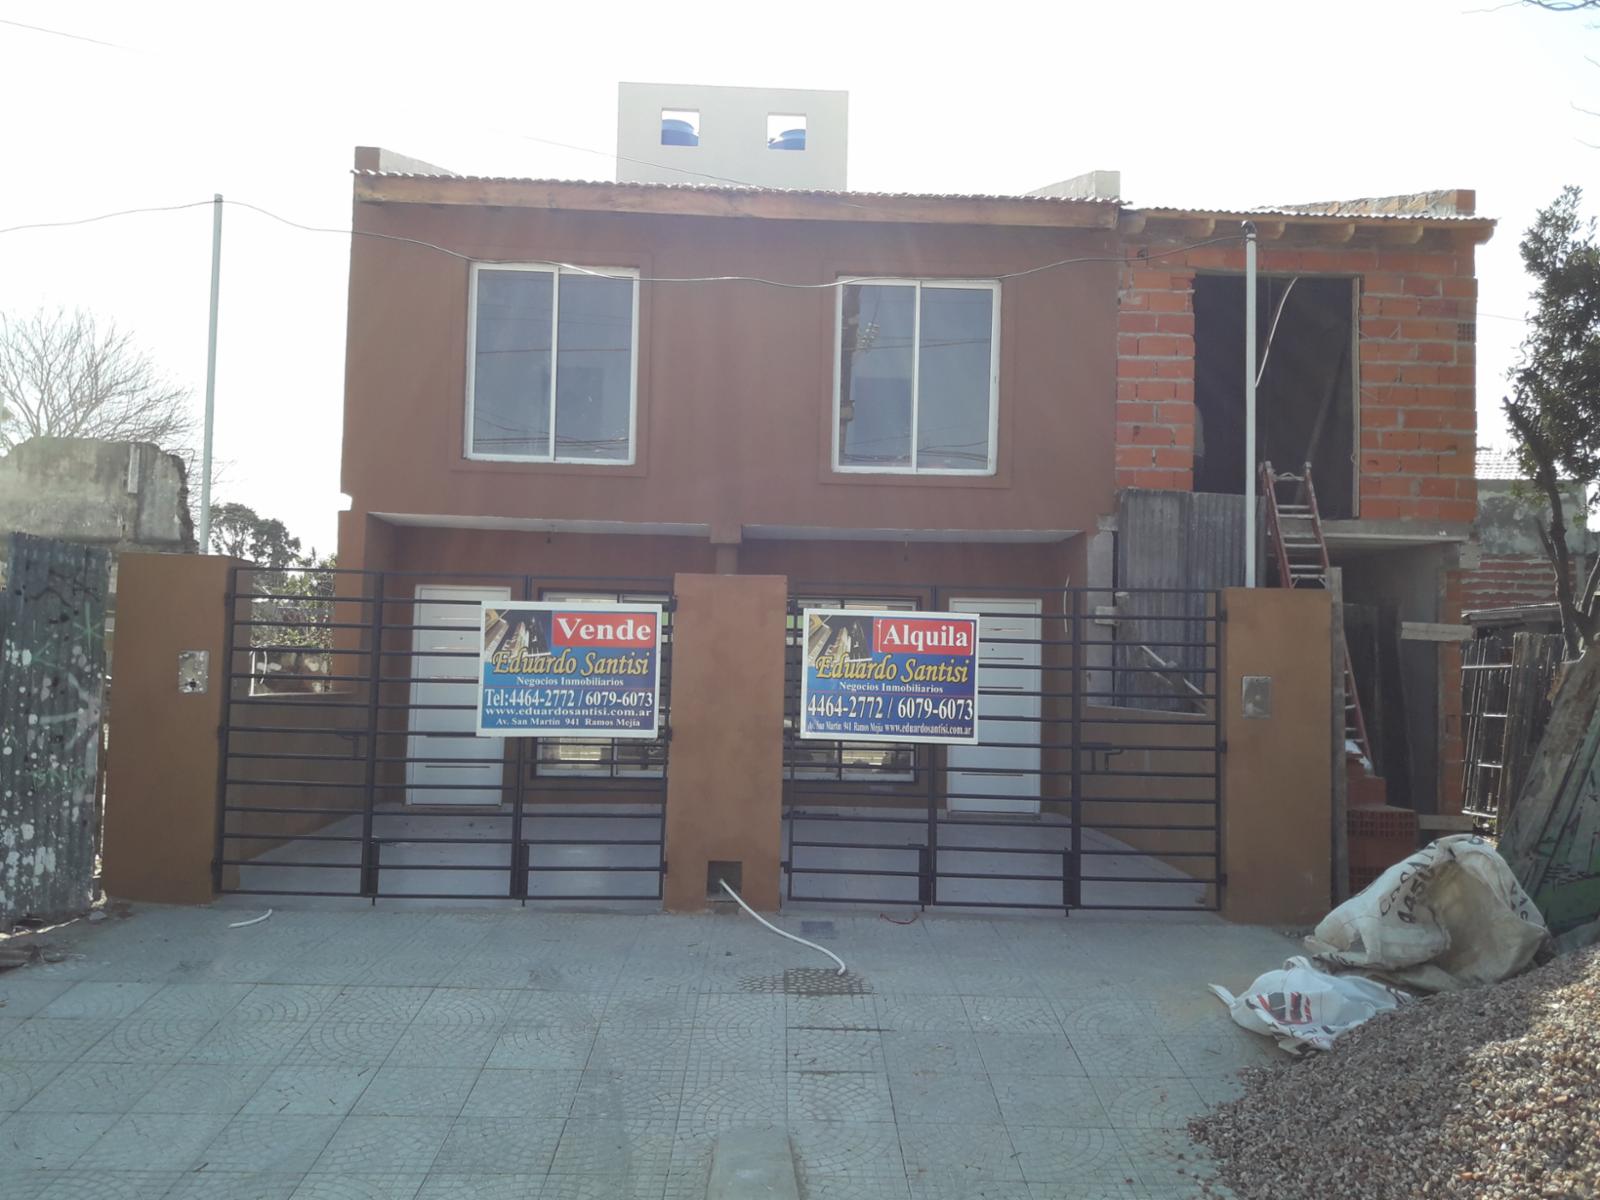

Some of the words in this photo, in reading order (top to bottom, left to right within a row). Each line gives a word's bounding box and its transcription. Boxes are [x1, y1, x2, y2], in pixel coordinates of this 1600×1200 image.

[557, 618, 651, 640] Vende
[883, 624, 968, 651] Alquila
[492, 648, 577, 674] Eduardo
[580, 652, 649, 675] Santisi
[815, 653, 897, 680] Eduardo
[901, 658, 970, 683] Santisi
[516, 677, 558, 687] Negocios
[561, 677, 624, 687] Inmobiliarios
[839, 682, 879, 692] Negocios
[882, 683, 943, 693] Inmobiliarios
[485, 689, 575, 707] Tel:4464-2772
[585, 692, 653, 707] 6079-6073
[807, 694, 883, 718] 4464-2772
[898, 698, 973, 720] 6079-6073
[485, 707, 652, 717] www.eduardosantisi.com.ar
[496, 718, 509, 726] Av.
[512, 718, 528, 726] San
[565, 718, 579, 726] 941
[585, 719, 614, 727] Ramos
[884, 723, 972, 735] www.eduardosantisi.com.ar
